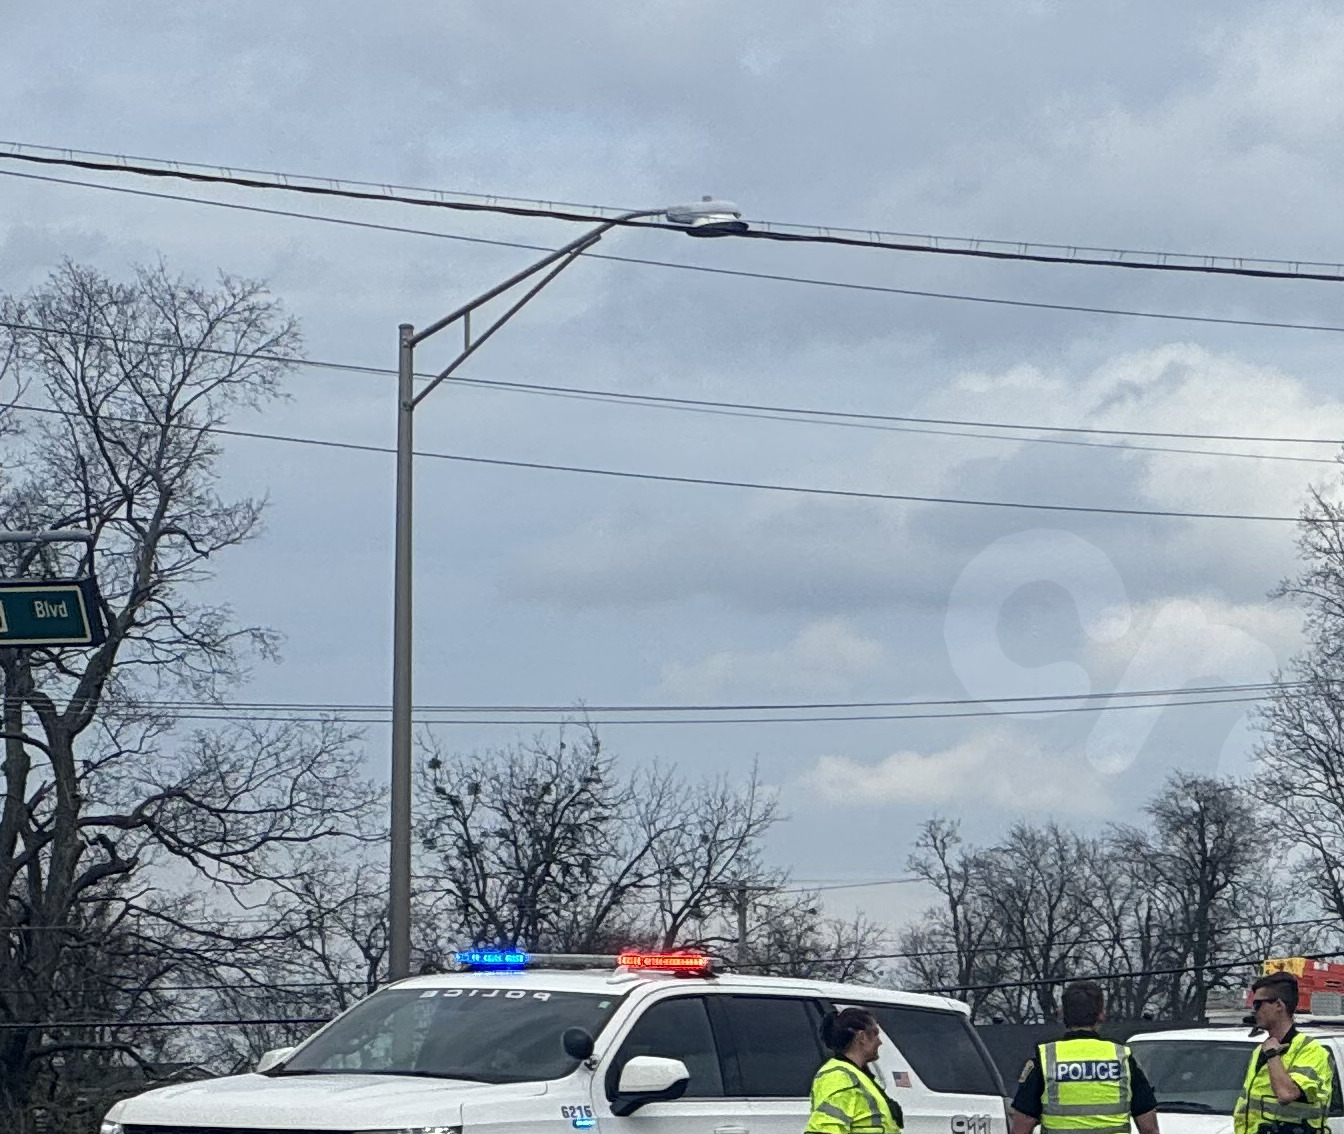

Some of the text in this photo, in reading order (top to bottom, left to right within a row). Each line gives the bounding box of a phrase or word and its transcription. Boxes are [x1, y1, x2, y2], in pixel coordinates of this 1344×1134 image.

[34, 601, 69, 618] Blvd
[1057, 1062, 1121, 1081] POLICE
[561, 1105, 593, 1119] 6216
